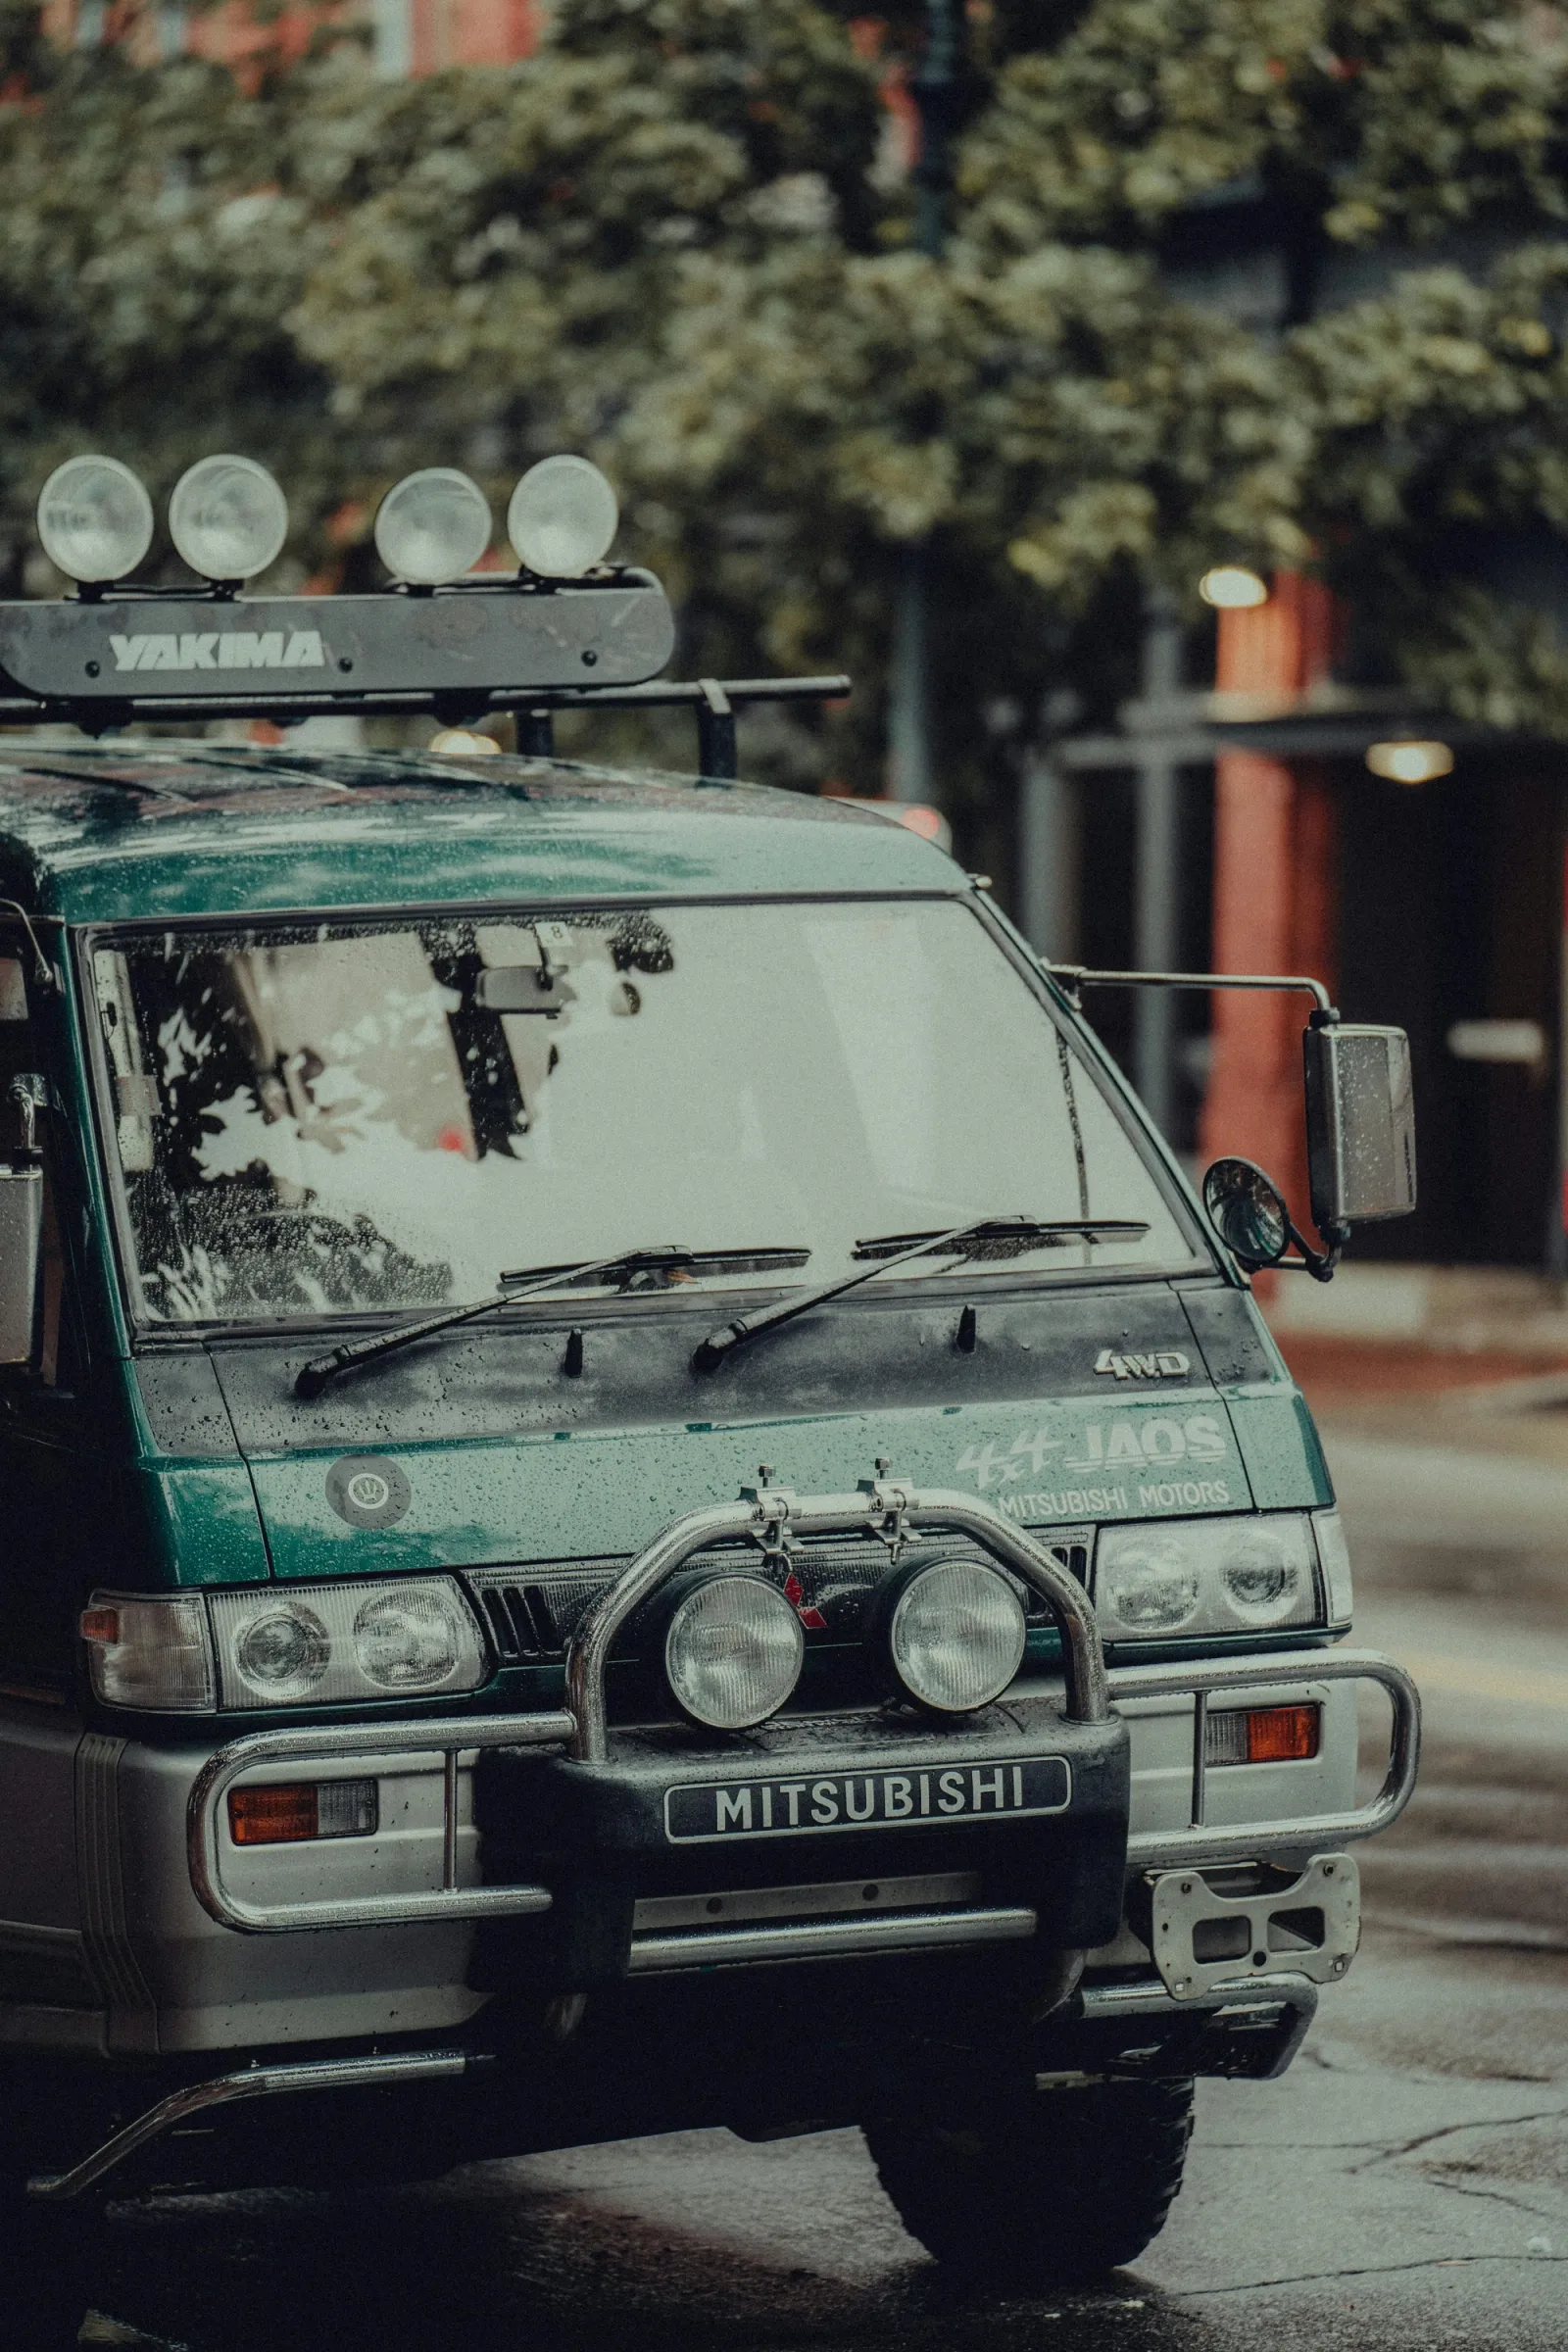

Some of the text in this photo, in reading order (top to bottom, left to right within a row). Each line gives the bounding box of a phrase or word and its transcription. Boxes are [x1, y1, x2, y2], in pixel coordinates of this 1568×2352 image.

[109, 631, 325, 670] YAKIMA
[1094, 1348, 1190, 1380] 4WD
[1063, 1416, 1227, 1472] JAOS
[998, 1480, 1230, 1519] MITSUBISHI MOTORS
[716, 1767, 1022, 1832] MITSUBISHI
